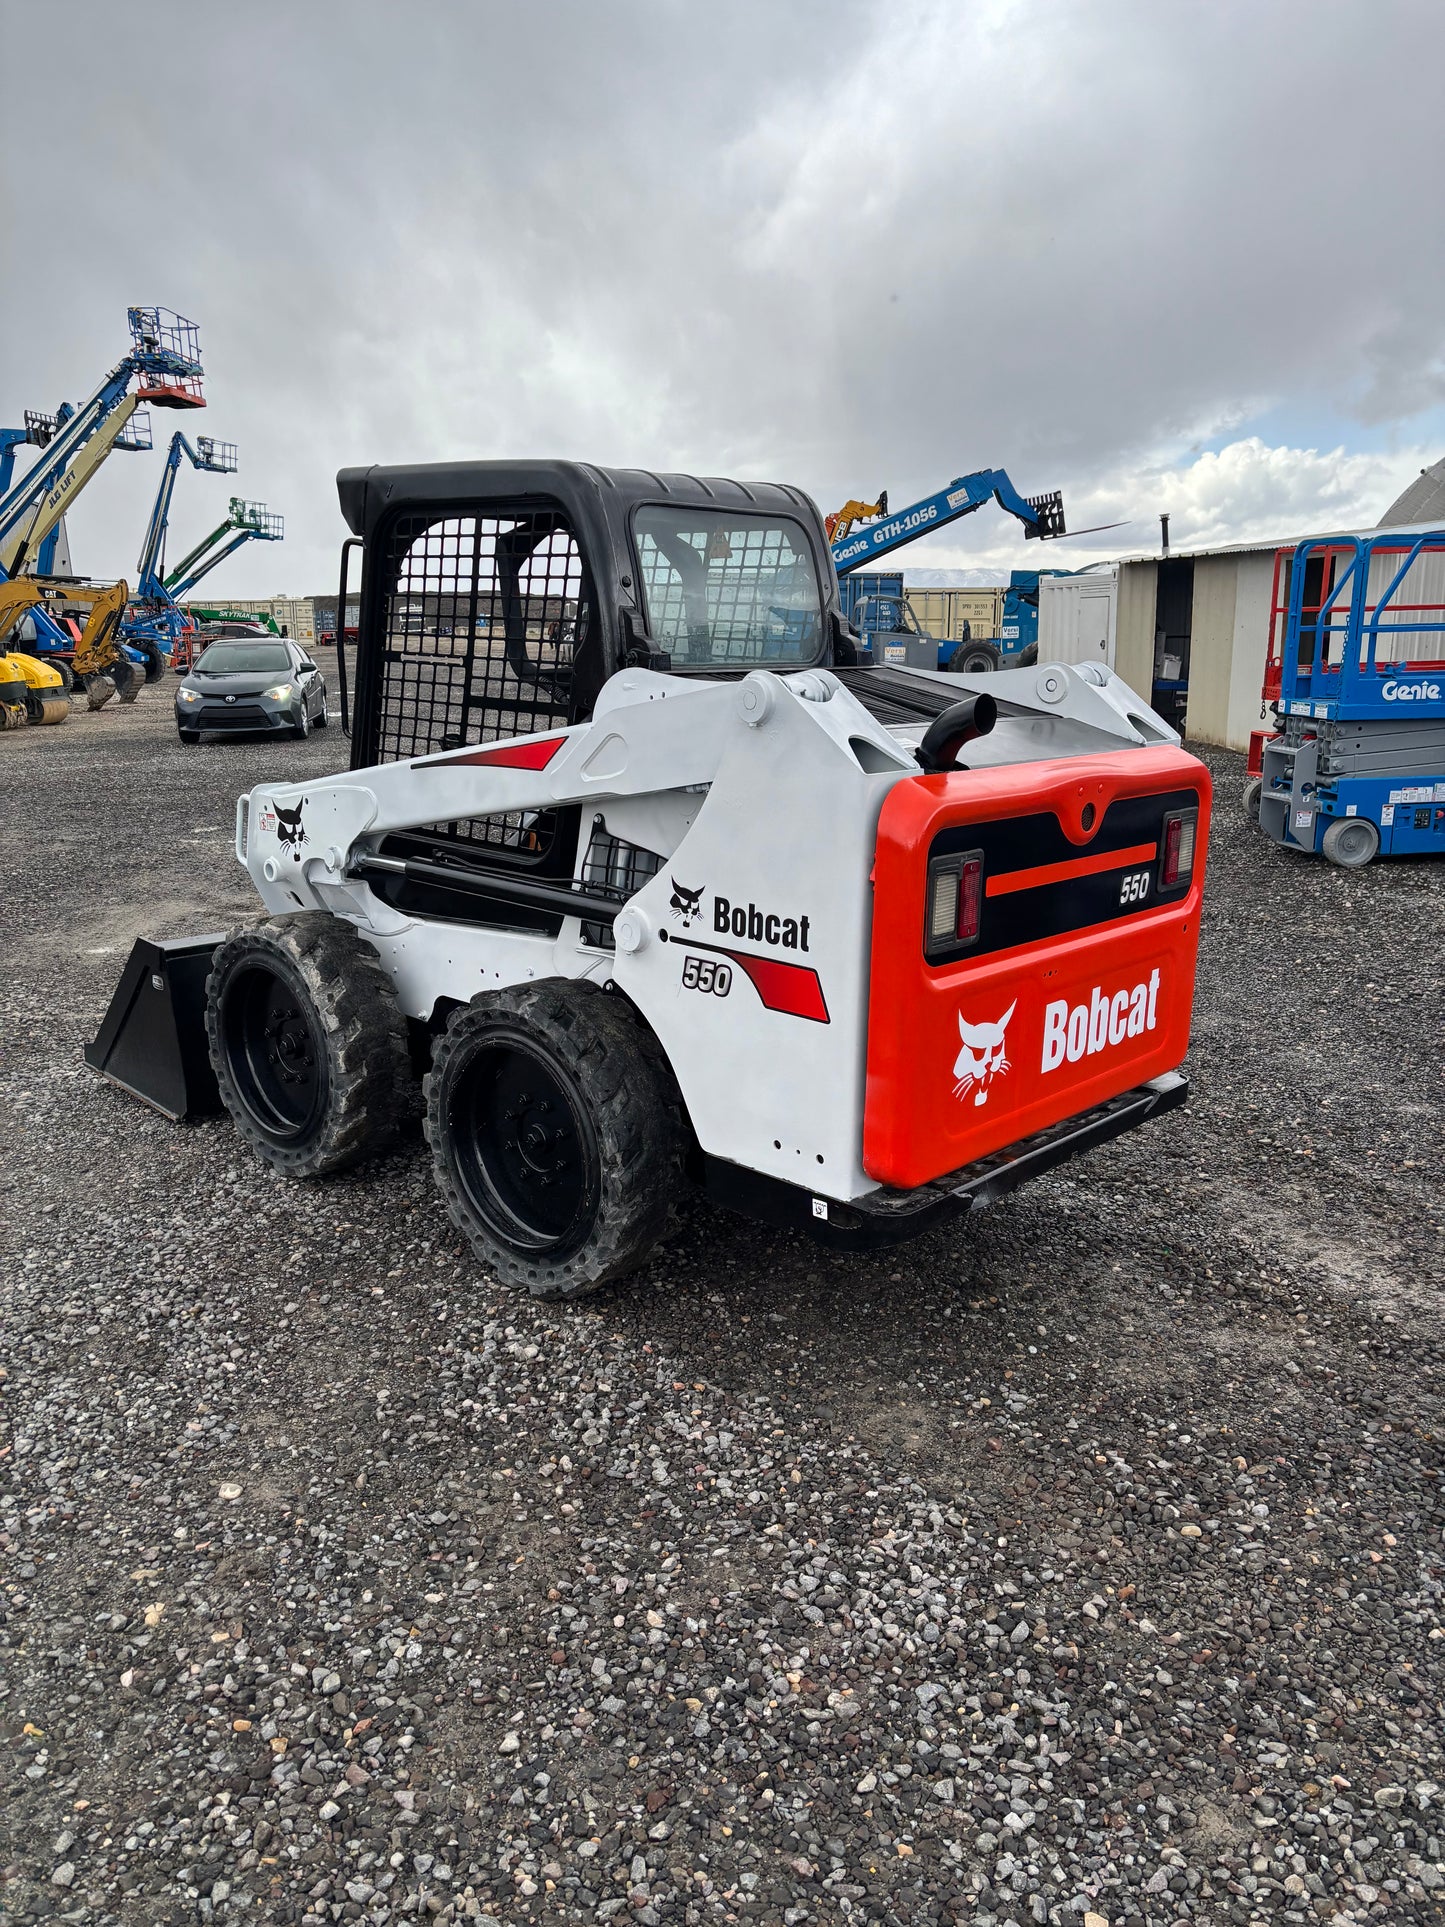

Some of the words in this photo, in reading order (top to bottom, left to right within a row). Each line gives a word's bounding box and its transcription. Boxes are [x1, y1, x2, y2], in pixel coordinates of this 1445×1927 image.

[48, 489, 62, 509] JLG
[60, 469, 76, 492] LIFT
[832, 540, 869, 562] Genie
[873, 505, 937, 543] GTH-1056
[44, 590, 57, 598] CAT
[219, 610, 250, 619] SKYTRAK
[1382, 681, 1440, 700] Genie
[1120, 871, 1150, 904] 550
[714, 896, 810, 952] Bobcat
[682, 955, 733, 997] 550
[1041, 968, 1160, 1074] Bobcat
